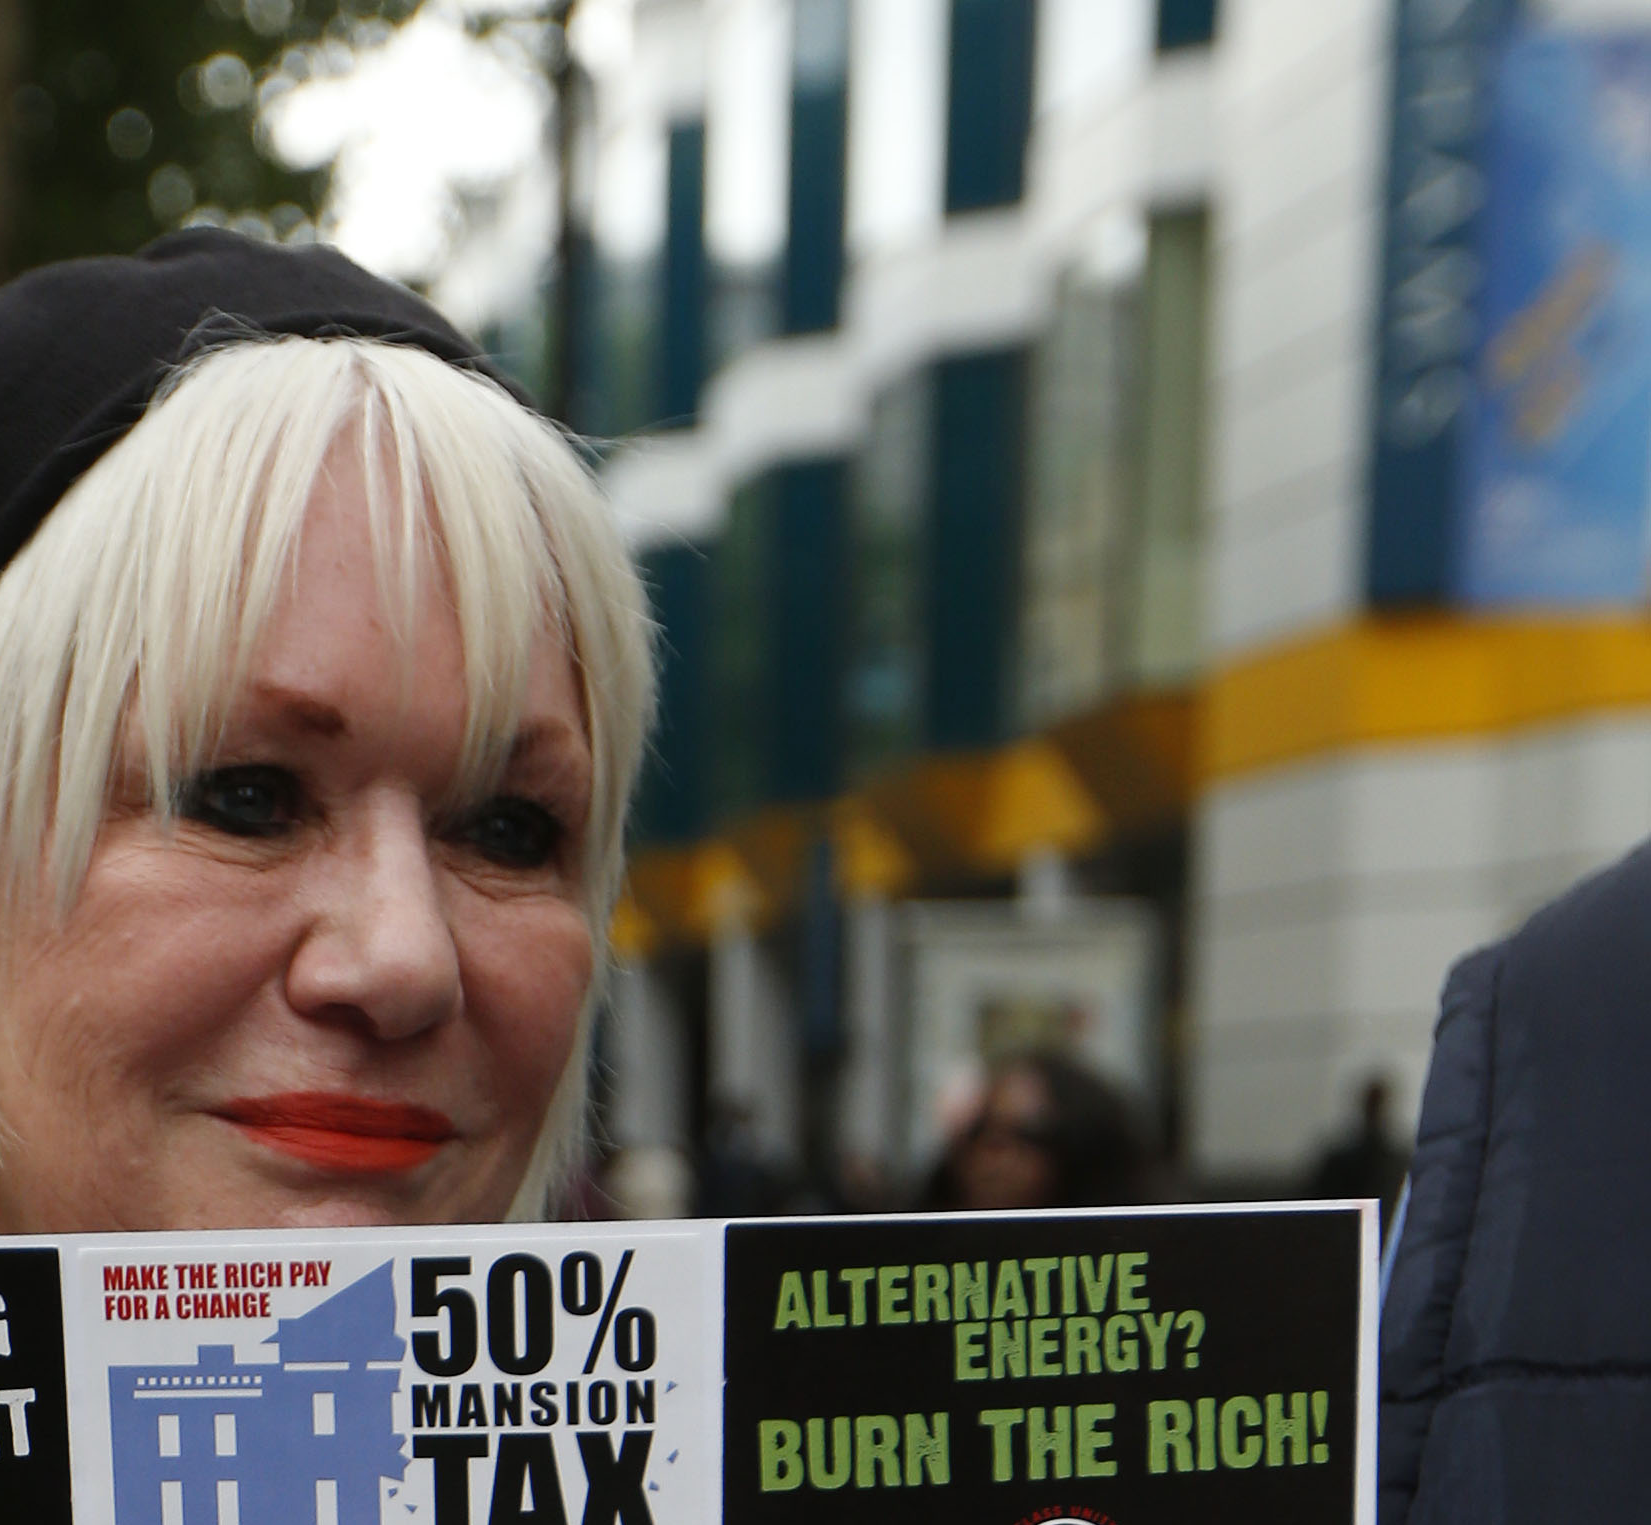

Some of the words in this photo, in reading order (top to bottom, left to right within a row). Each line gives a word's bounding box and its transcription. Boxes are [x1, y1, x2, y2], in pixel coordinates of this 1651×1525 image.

[103, 1265, 169, 1291] MAKE
[174, 1263, 218, 1289] THE
[224, 1261, 283, 1288] RICH
[289, 1260, 332, 1287] PAY
[105, 1294, 149, 1321] FOR
[155, 1294, 171, 1320] A
[176, 1292, 272, 1319] CHANGE
[773, 1252, 1151, 1331] ALTERNATIVE
[410, 1249, 657, 1377] 50%
[955, 1310, 1207, 1381] ENERGY?
[411, 1379, 657, 1428] MANSION
[757, 1411, 950, 1492] BURN
[979, 1403, 1117, 1482] THE
[1148, 1390, 1330, 1475] RICH!
